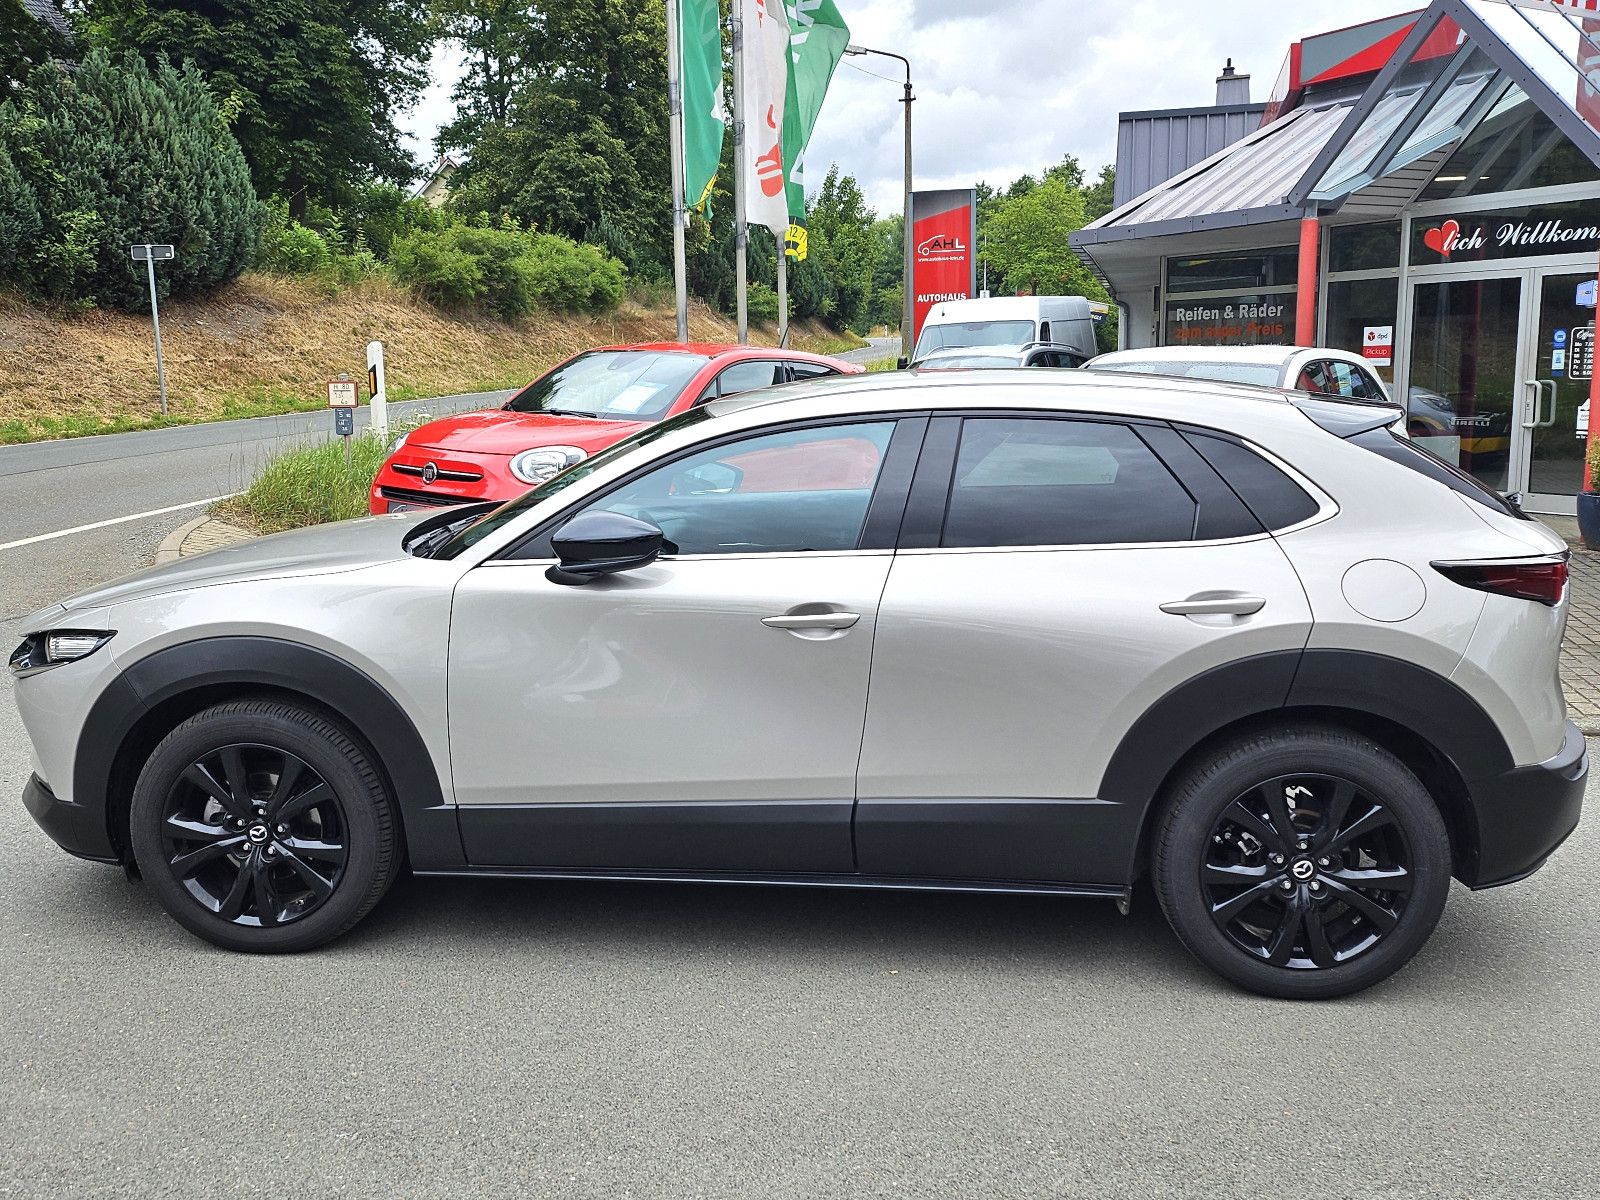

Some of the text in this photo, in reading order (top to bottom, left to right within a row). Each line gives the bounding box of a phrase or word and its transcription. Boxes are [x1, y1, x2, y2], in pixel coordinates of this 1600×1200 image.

[931, 238, 966, 249] AHL
[917, 292, 967, 303] AUTOHAUS
[1176, 303, 1284, 322] Reifen & Räder
